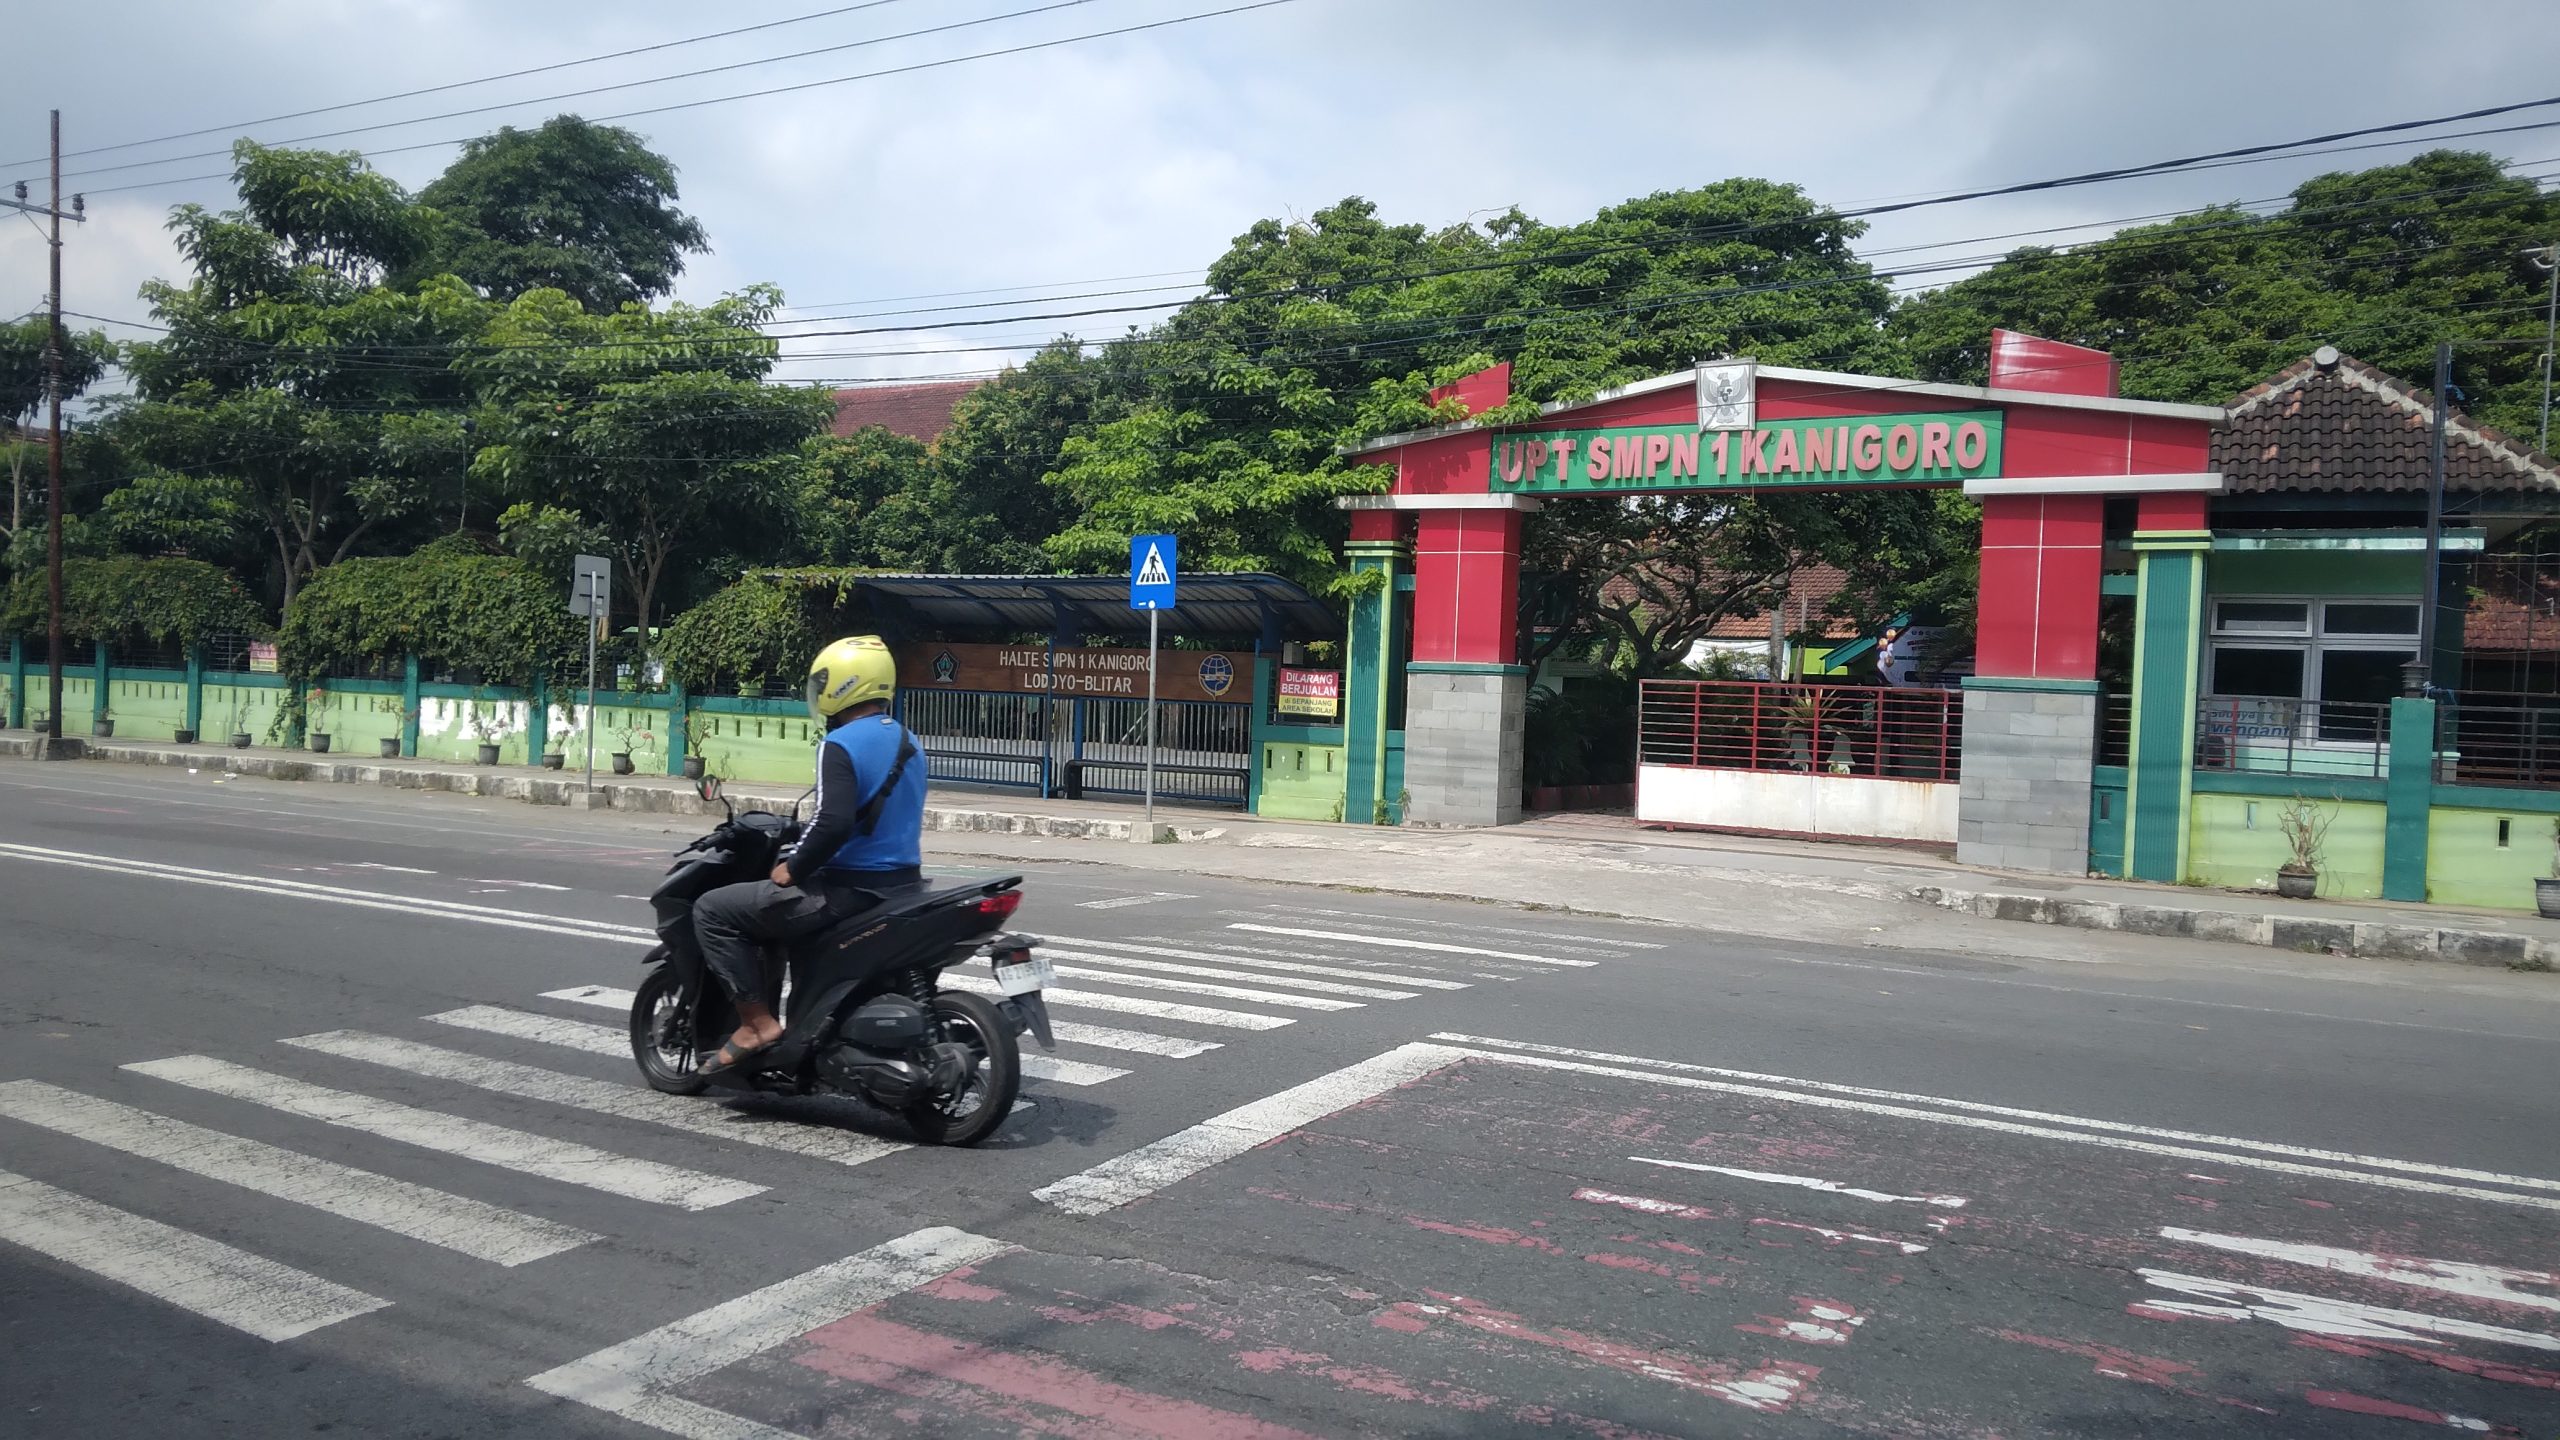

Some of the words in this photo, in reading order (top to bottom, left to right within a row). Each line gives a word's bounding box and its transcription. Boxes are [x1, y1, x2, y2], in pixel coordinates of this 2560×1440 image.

[1499, 436, 1576, 484] UPT
[1587, 432, 1699, 481] SMPN
[1711, 431, 1728, 477] 1
[1742, 421, 1987, 476] KANIGORO
[1000, 651, 1039, 667] HALTE
[1079, 653, 1084, 669] 1
[1287, 672, 1333, 685] DILARANG
[1281, 683, 1337, 697] BERJUALAN
[1292, 698, 1332, 706] SEPANJANG
